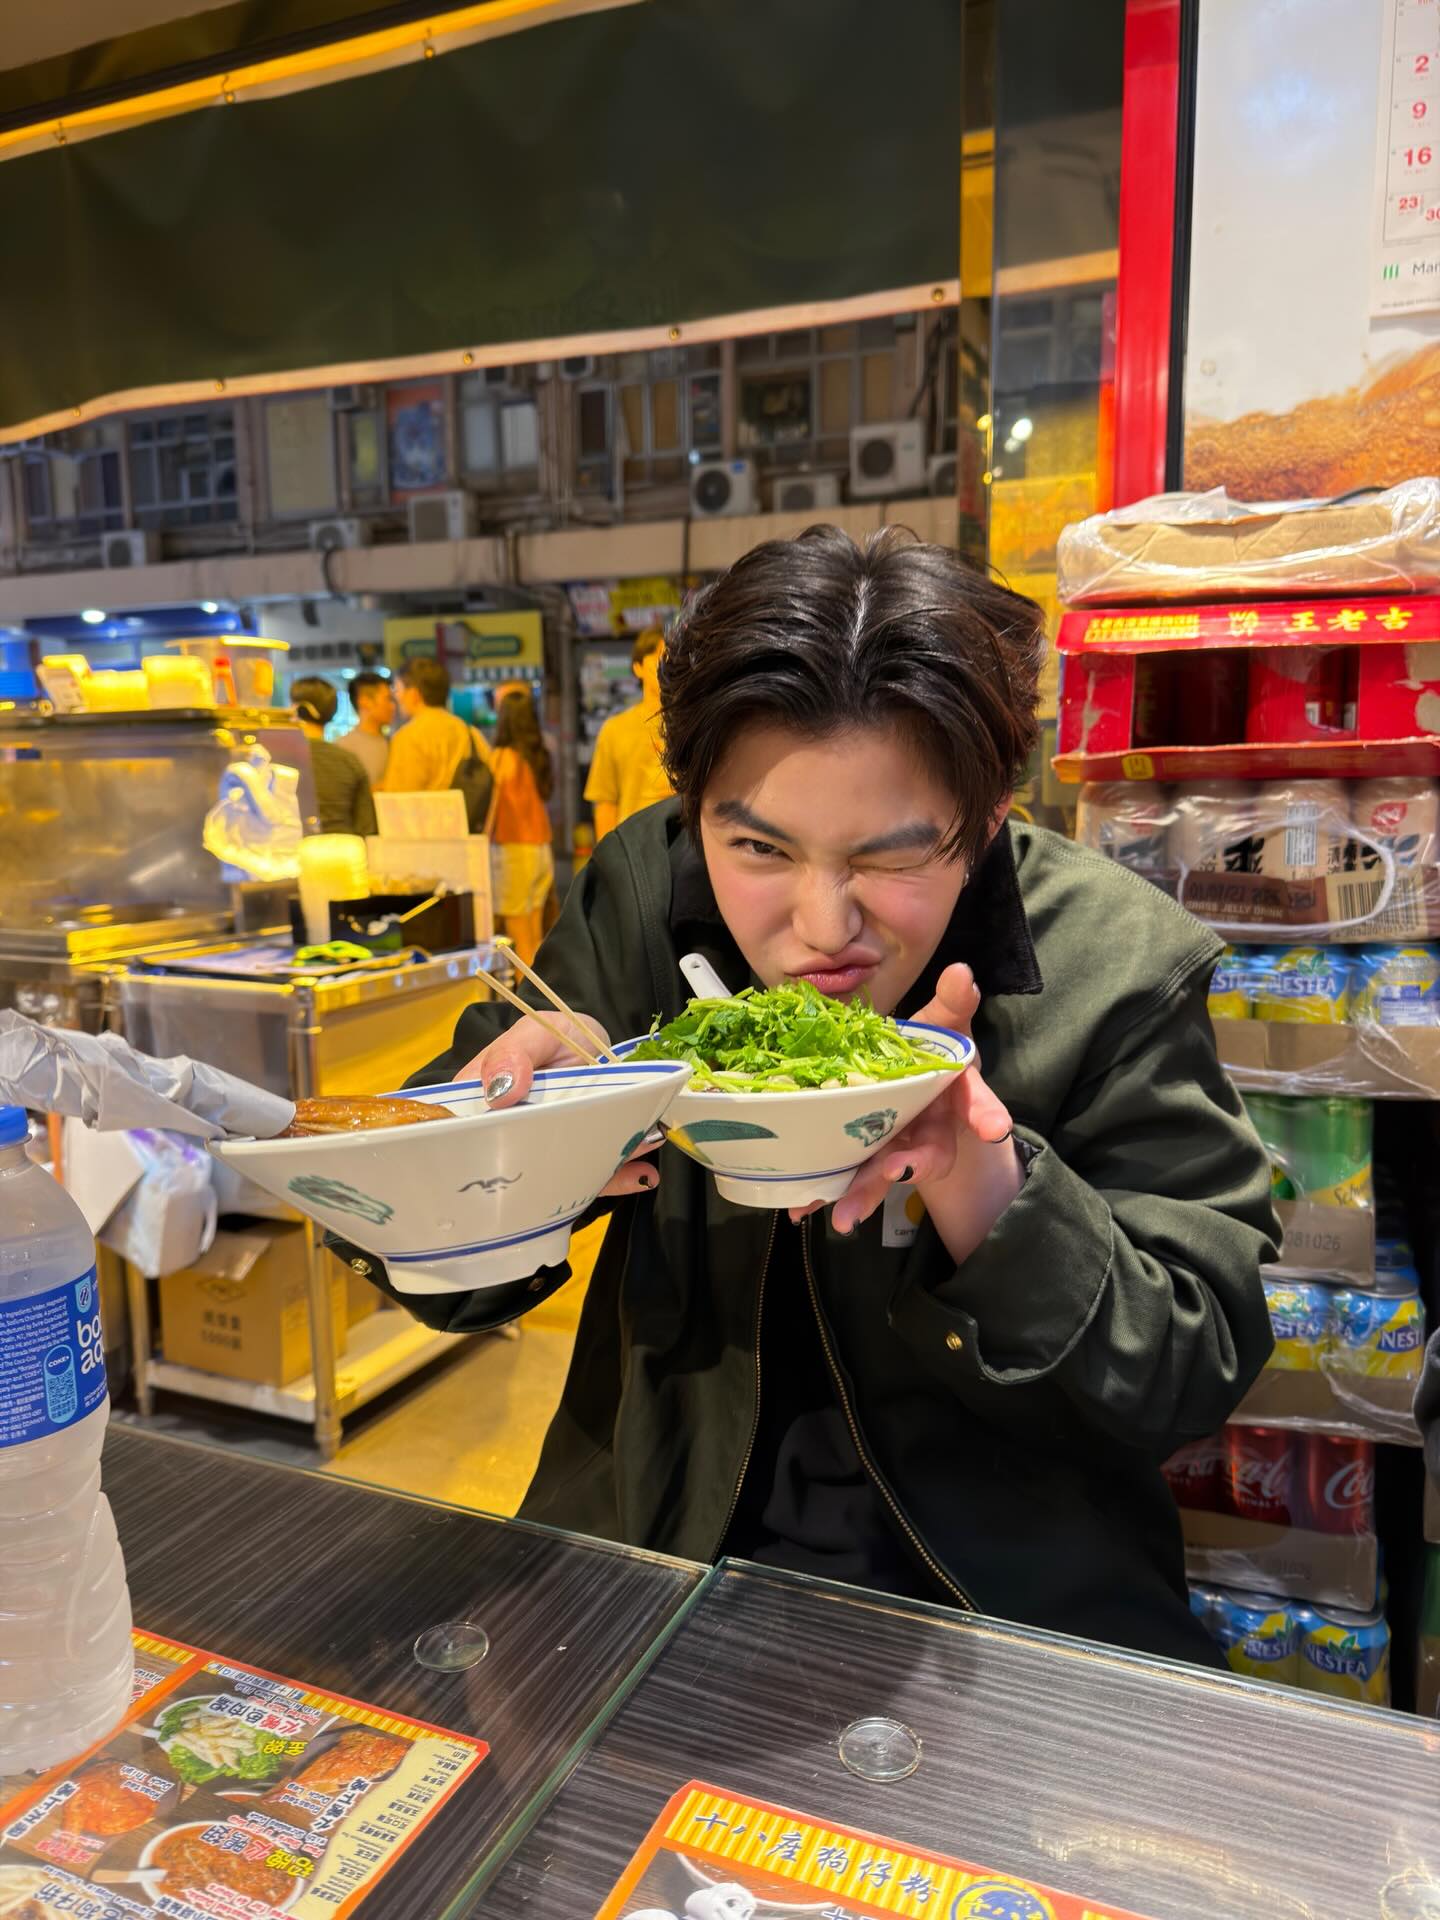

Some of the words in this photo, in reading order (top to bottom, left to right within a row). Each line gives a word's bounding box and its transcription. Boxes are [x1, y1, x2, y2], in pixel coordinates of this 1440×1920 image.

[1415, 55, 1429, 73] 2
[1413, 102, 1427, 119] 9
[1405, 146, 1432, 166] 16
[1399, 196, 1418, 210] 23
[1284, 606, 1413, 632] 王老吉
[1221, 902, 1251, 914] JELLY
[77, 1313, 102, 1348] bo
[80, 1339, 104, 1375] aq
[1306, 1642, 1368, 1676] NESTEA
[119, 1765, 146, 1780] Thigh
[123, 1781, 161, 1800] Roasted
[148, 1776, 174, 1791] Duck
[286, 1782, 305, 1793] Leg
[280, 1794, 321, 1813] Roasted
[306, 1791, 330, 1804] Duck
[226, 1813, 249, 1826] Soup
[246, 1812, 269, 1823] Duck
[267, 1819, 306, 1838] Shredded
[694, 1812, 940, 1904] 十八座狗仔粉
